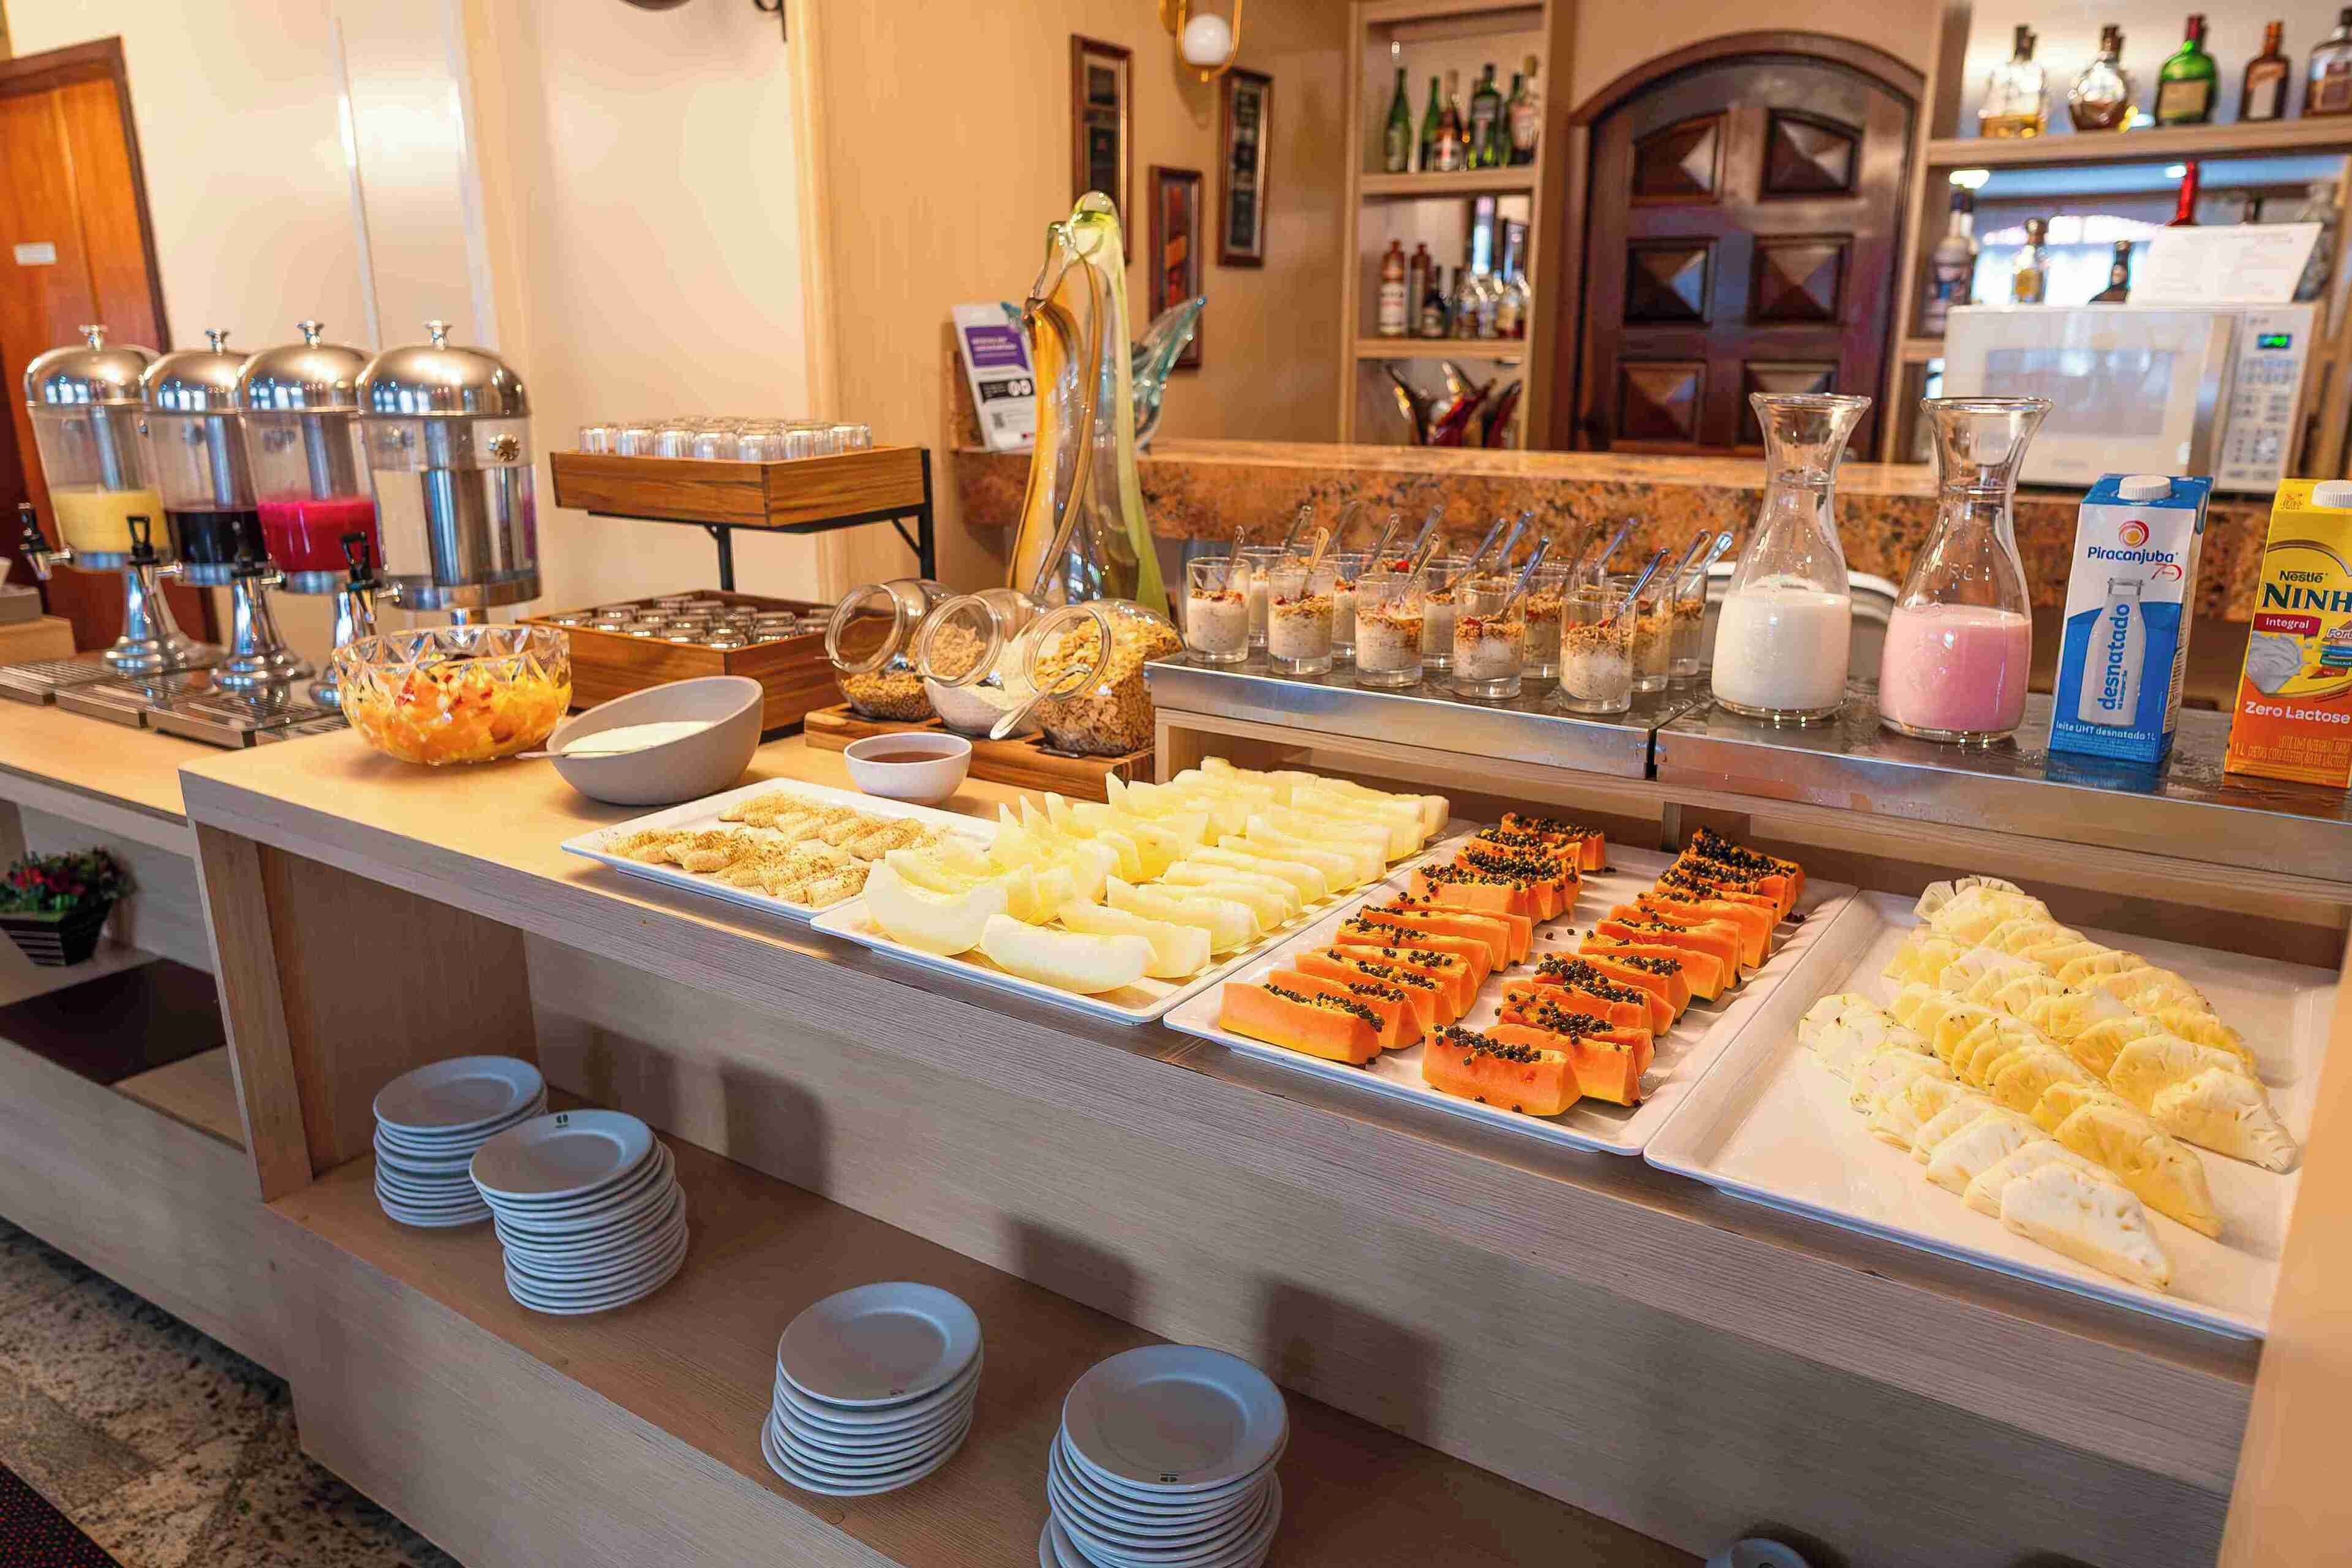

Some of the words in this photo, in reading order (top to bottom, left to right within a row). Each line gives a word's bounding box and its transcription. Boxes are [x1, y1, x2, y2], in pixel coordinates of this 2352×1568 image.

[2087, 546, 2174, 564] Piracanjuba
[2097, 603, 2130, 710] desnatado
[2245, 701, 2283, 717] Zero
[2285, 706, 2351, 724] Lactose
[2056, 720, 2074, 731] leite
[2075, 725, 2094, 735] UHT
[2096, 726, 2146, 741] desnatado
